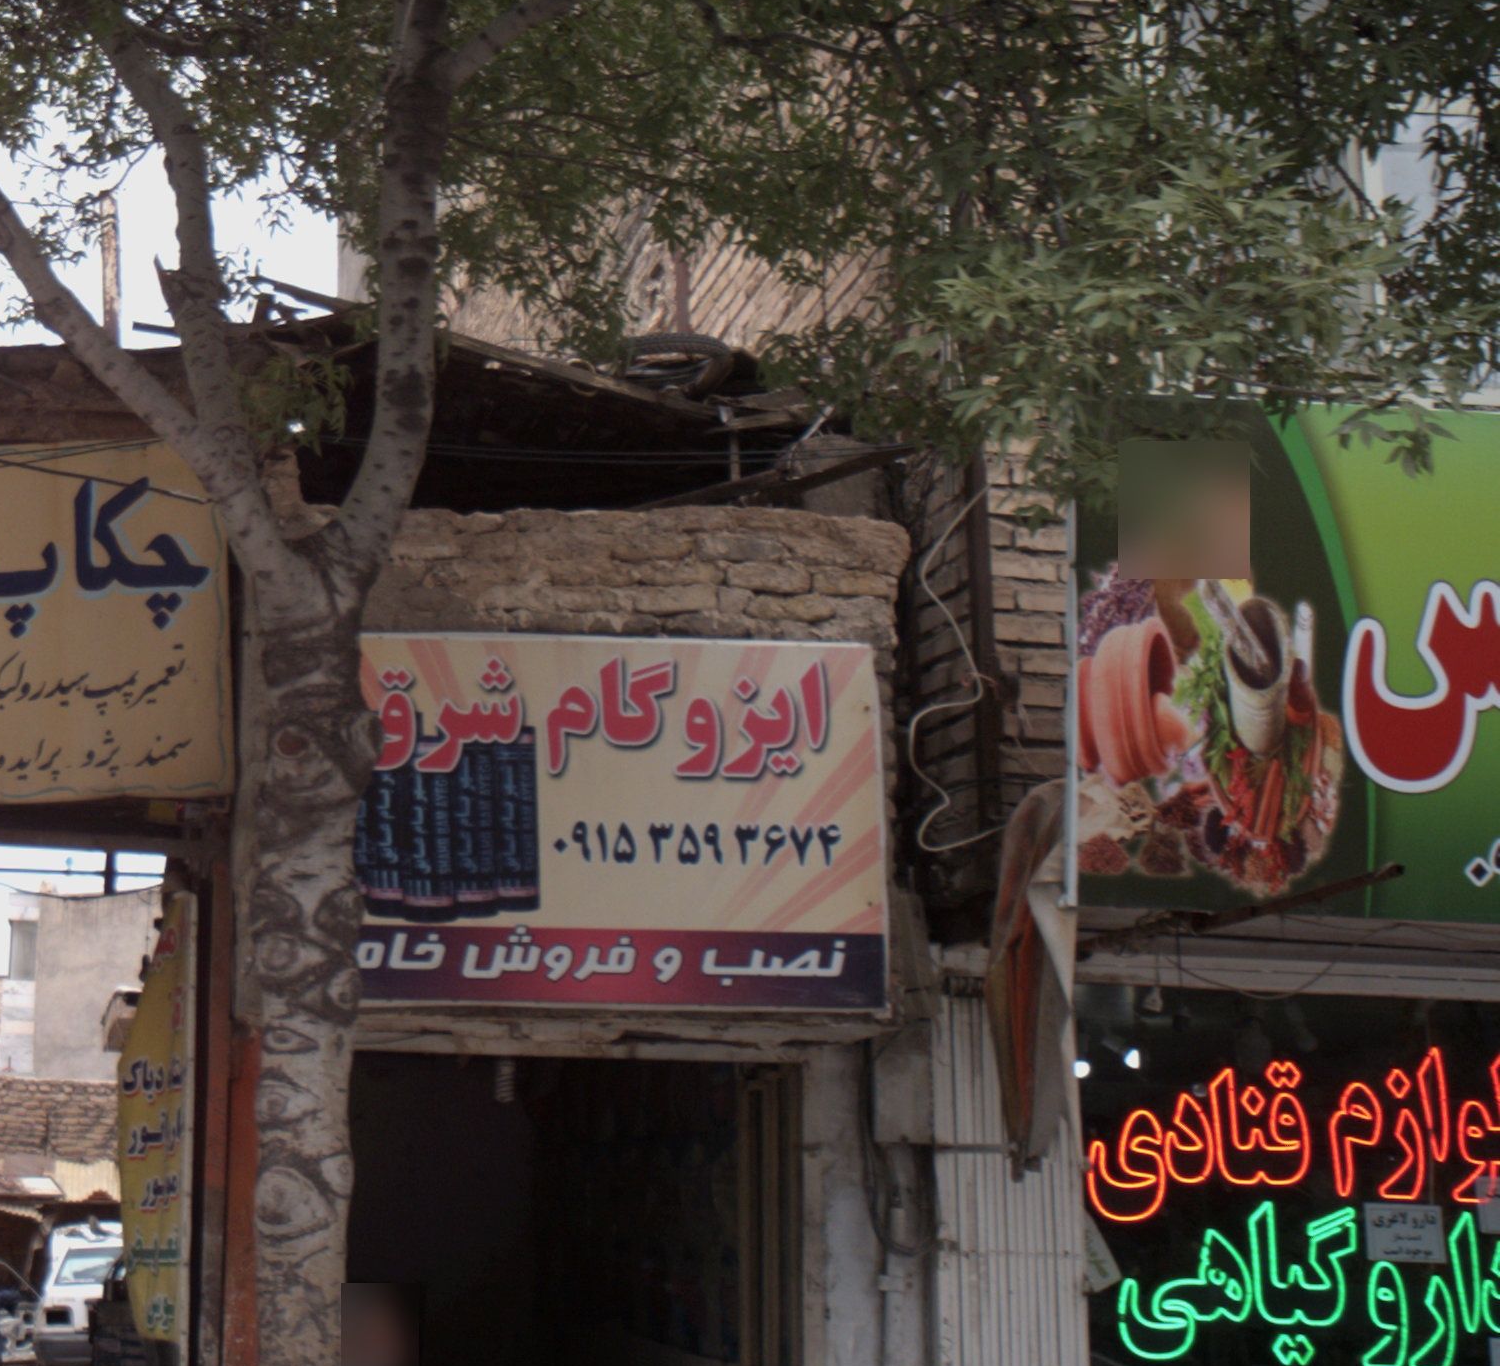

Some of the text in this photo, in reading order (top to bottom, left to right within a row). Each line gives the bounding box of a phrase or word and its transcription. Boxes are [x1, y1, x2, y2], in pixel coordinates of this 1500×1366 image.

[82, 670, 139, 716] پمپ
[126, 643, 187, 710] تعمیر
[373, 656, 827, 779] ایزوگام شرق
[7, 738, 62, 781] پراید
[80, 729, 121, 777] پژو
[135, 735, 192, 768] سمند
[552, 821, 637, 865] ۰۹۱۵
[461, 925, 636, 983] فروش
[652, 943, 682, 983] و
[702, 939, 846, 986] نصب
[1088, 1061, 1311, 1222] قنادی
[1118, 1201, 1357, 1366] گیاهی
